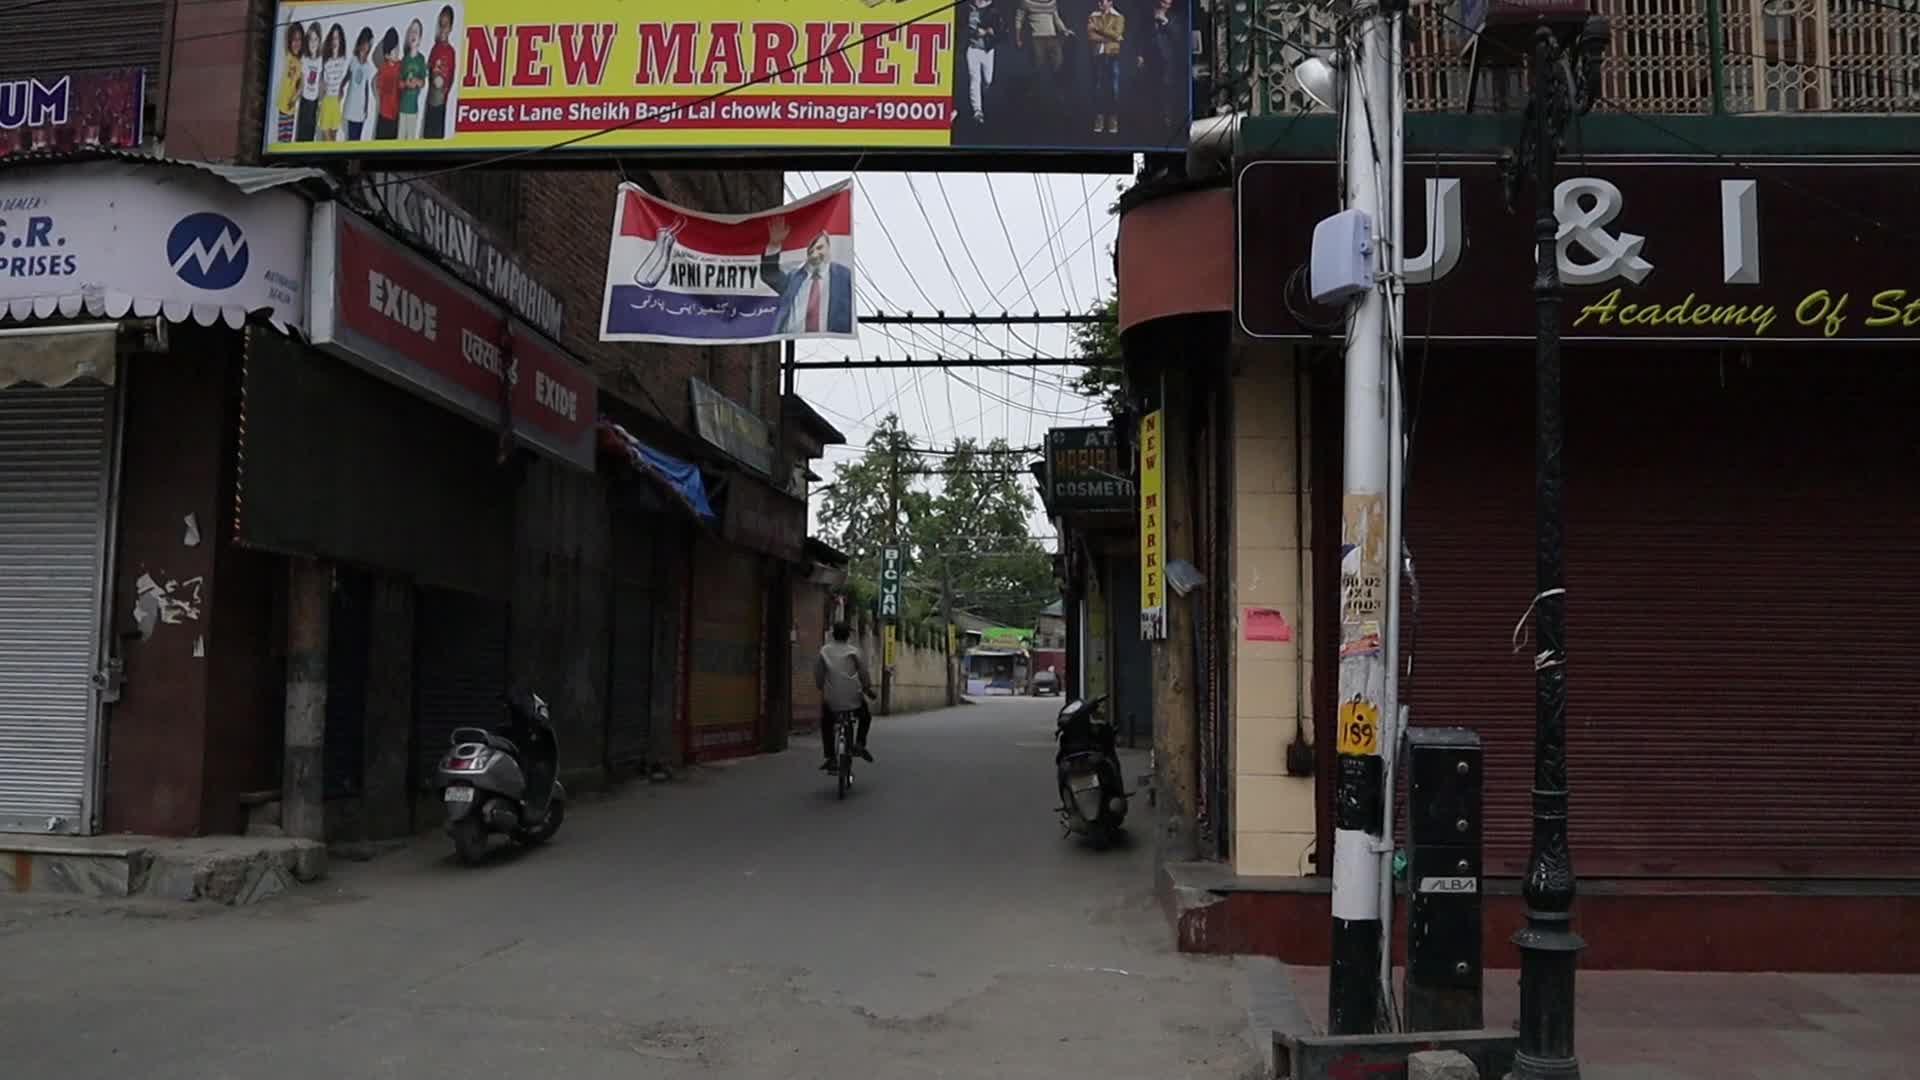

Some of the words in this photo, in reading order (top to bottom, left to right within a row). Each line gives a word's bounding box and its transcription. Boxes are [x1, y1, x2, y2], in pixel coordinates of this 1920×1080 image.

[462, 23, 618, 88] NEW
[634, 21, 952, 86] MARKET
[459, 104, 515, 122] Forest
[520, 104, 564, 121] Lane
[568, 102, 631, 120] Sheikh
[636, 102, 682, 124] Bagh
[688, 102, 718, 119] Lal
[721, 101, 781, 119] chowk
[1535, 177, 1655, 285] &
[1720, 179, 1760, 284] I
[486, 244, 562, 341] EMPORIUM
[669, 263, 700, 288] APNI
[705, 264, 758, 289] PARTY
[368, 269, 438, 341] EXIDE
[1573, 288, 1777, 335] Academy
[1795, 289, 1849, 337] Of
[535, 369, 577, 422] EXIDE
[1145, 416, 1157, 470] NEW
[1145, 493, 1158, 606] MARKET
[1343, 722, 1374, 747] 189
